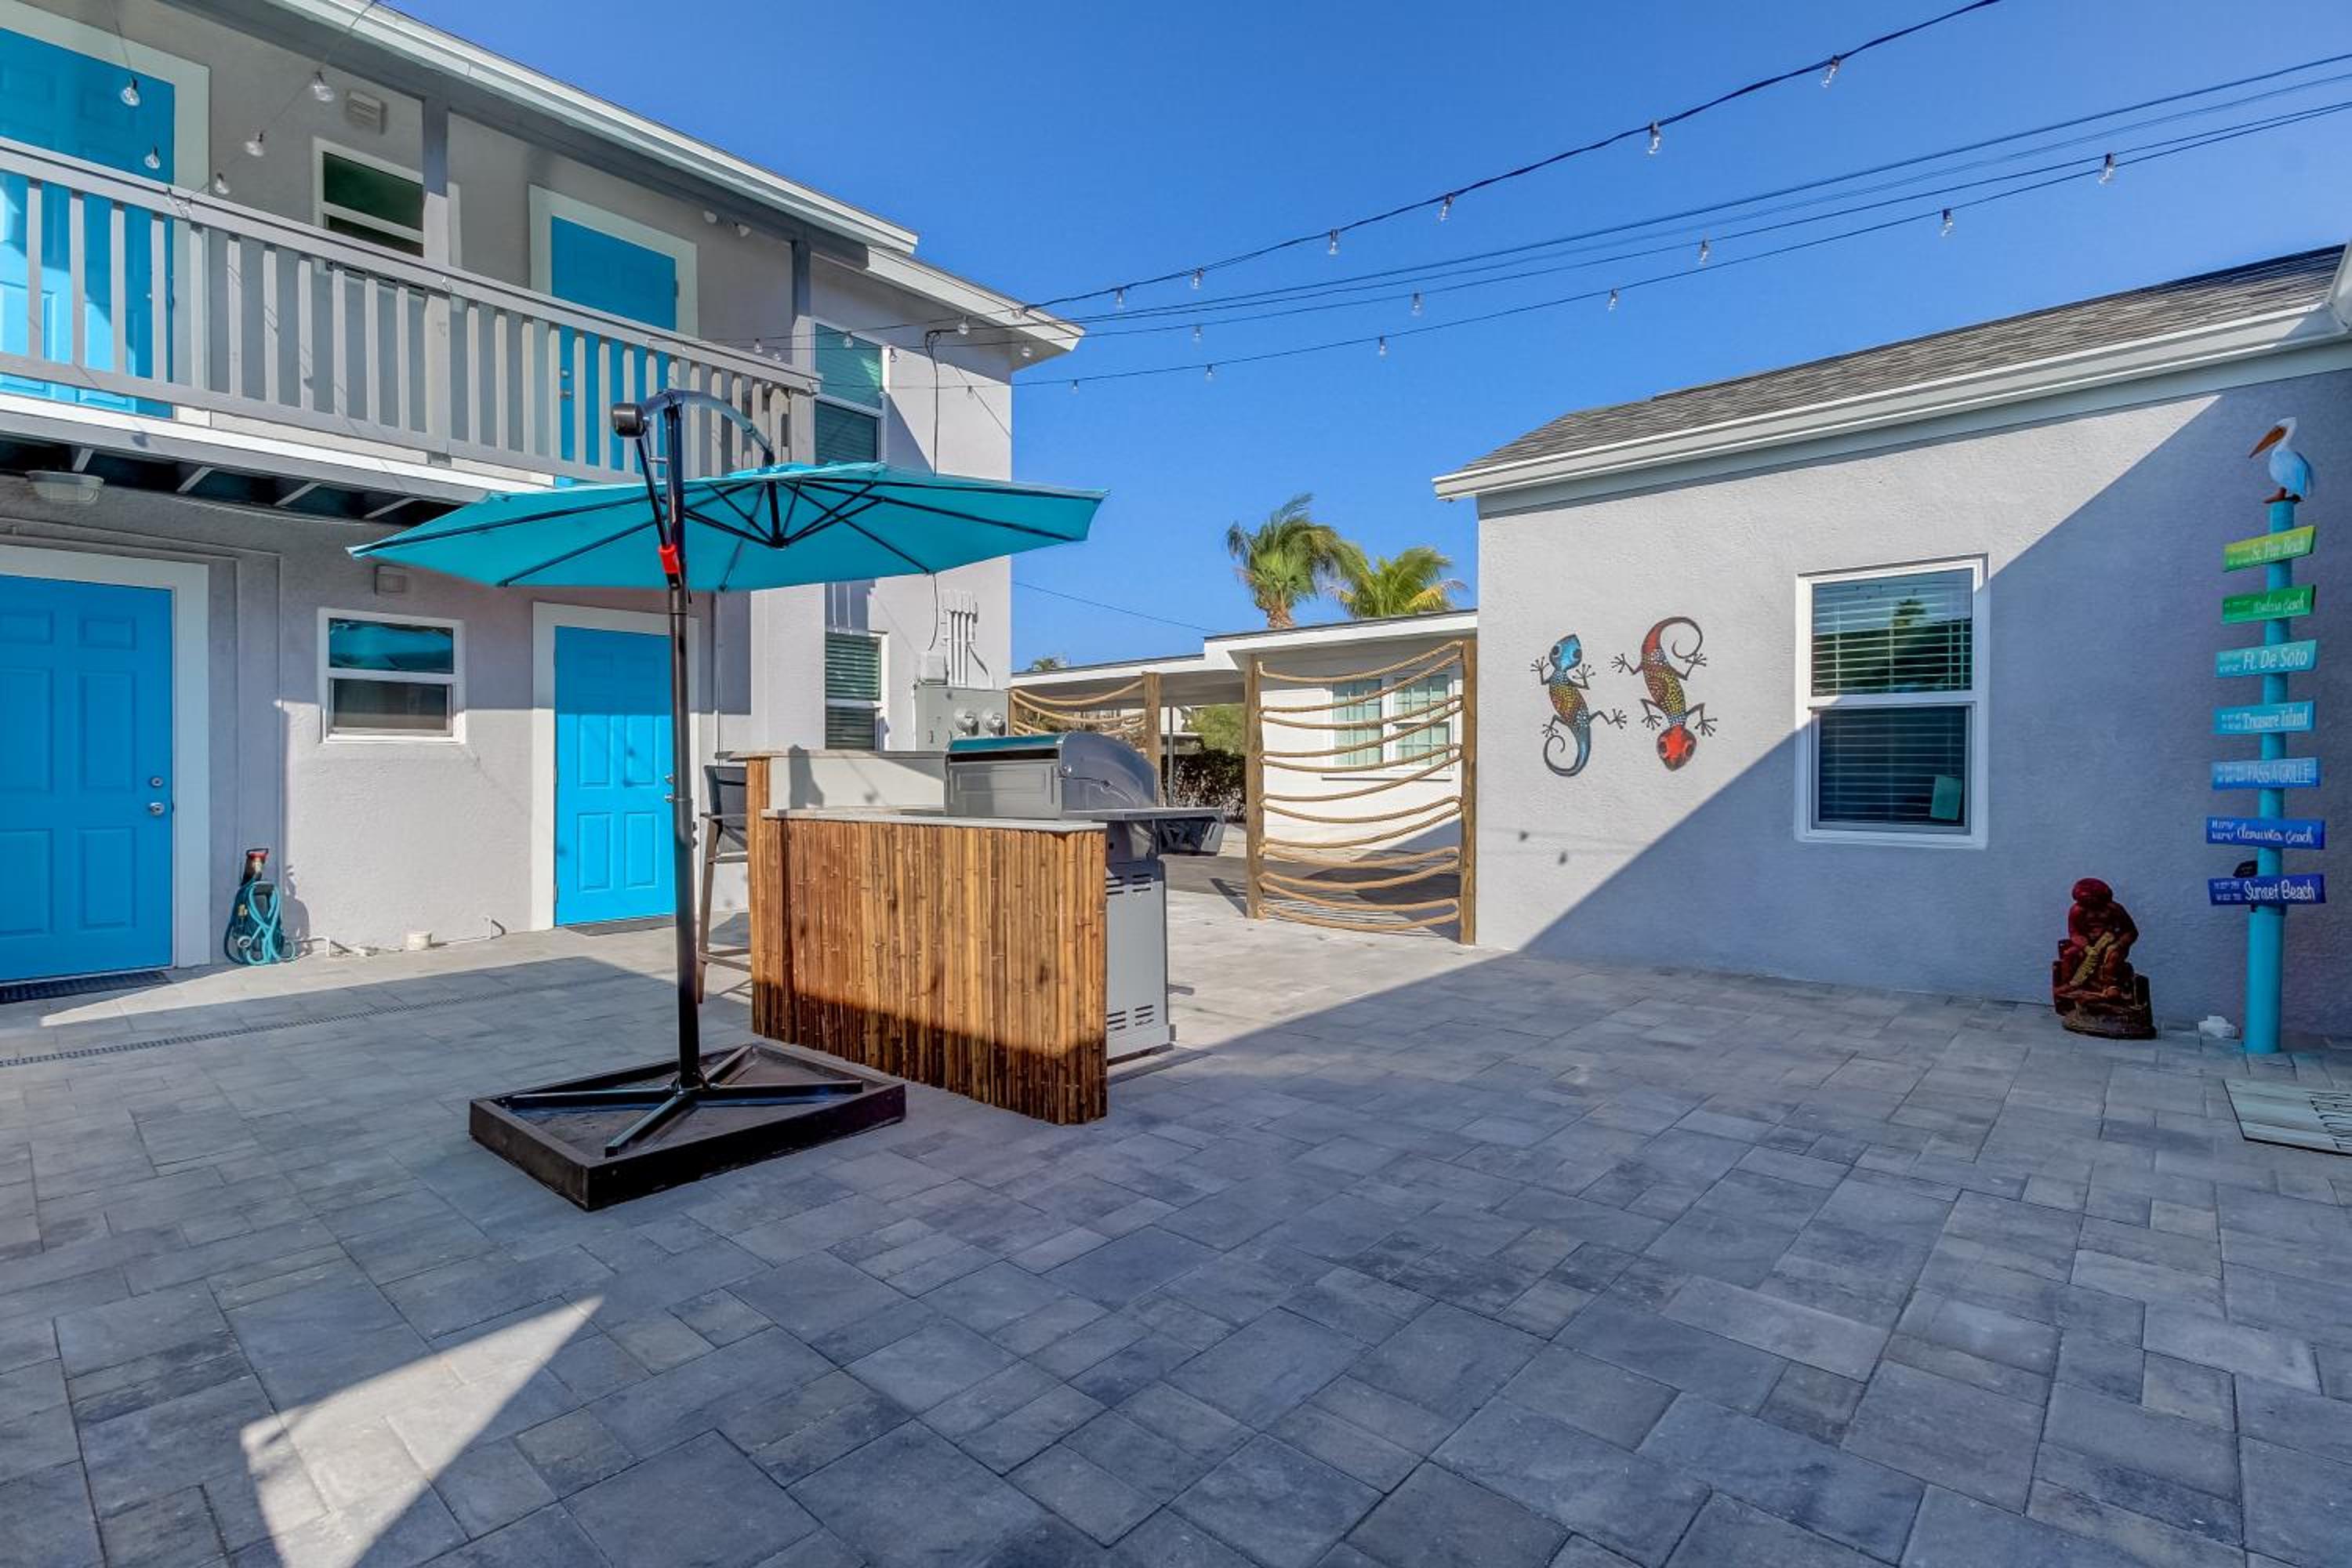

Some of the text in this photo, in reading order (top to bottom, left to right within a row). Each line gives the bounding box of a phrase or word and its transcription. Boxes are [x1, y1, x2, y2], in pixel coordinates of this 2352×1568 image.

[2260, 650, 2278, 669] De
[2280, 647, 2308, 666] Soto
[2243, 879, 2316, 901] Sunset Beach
